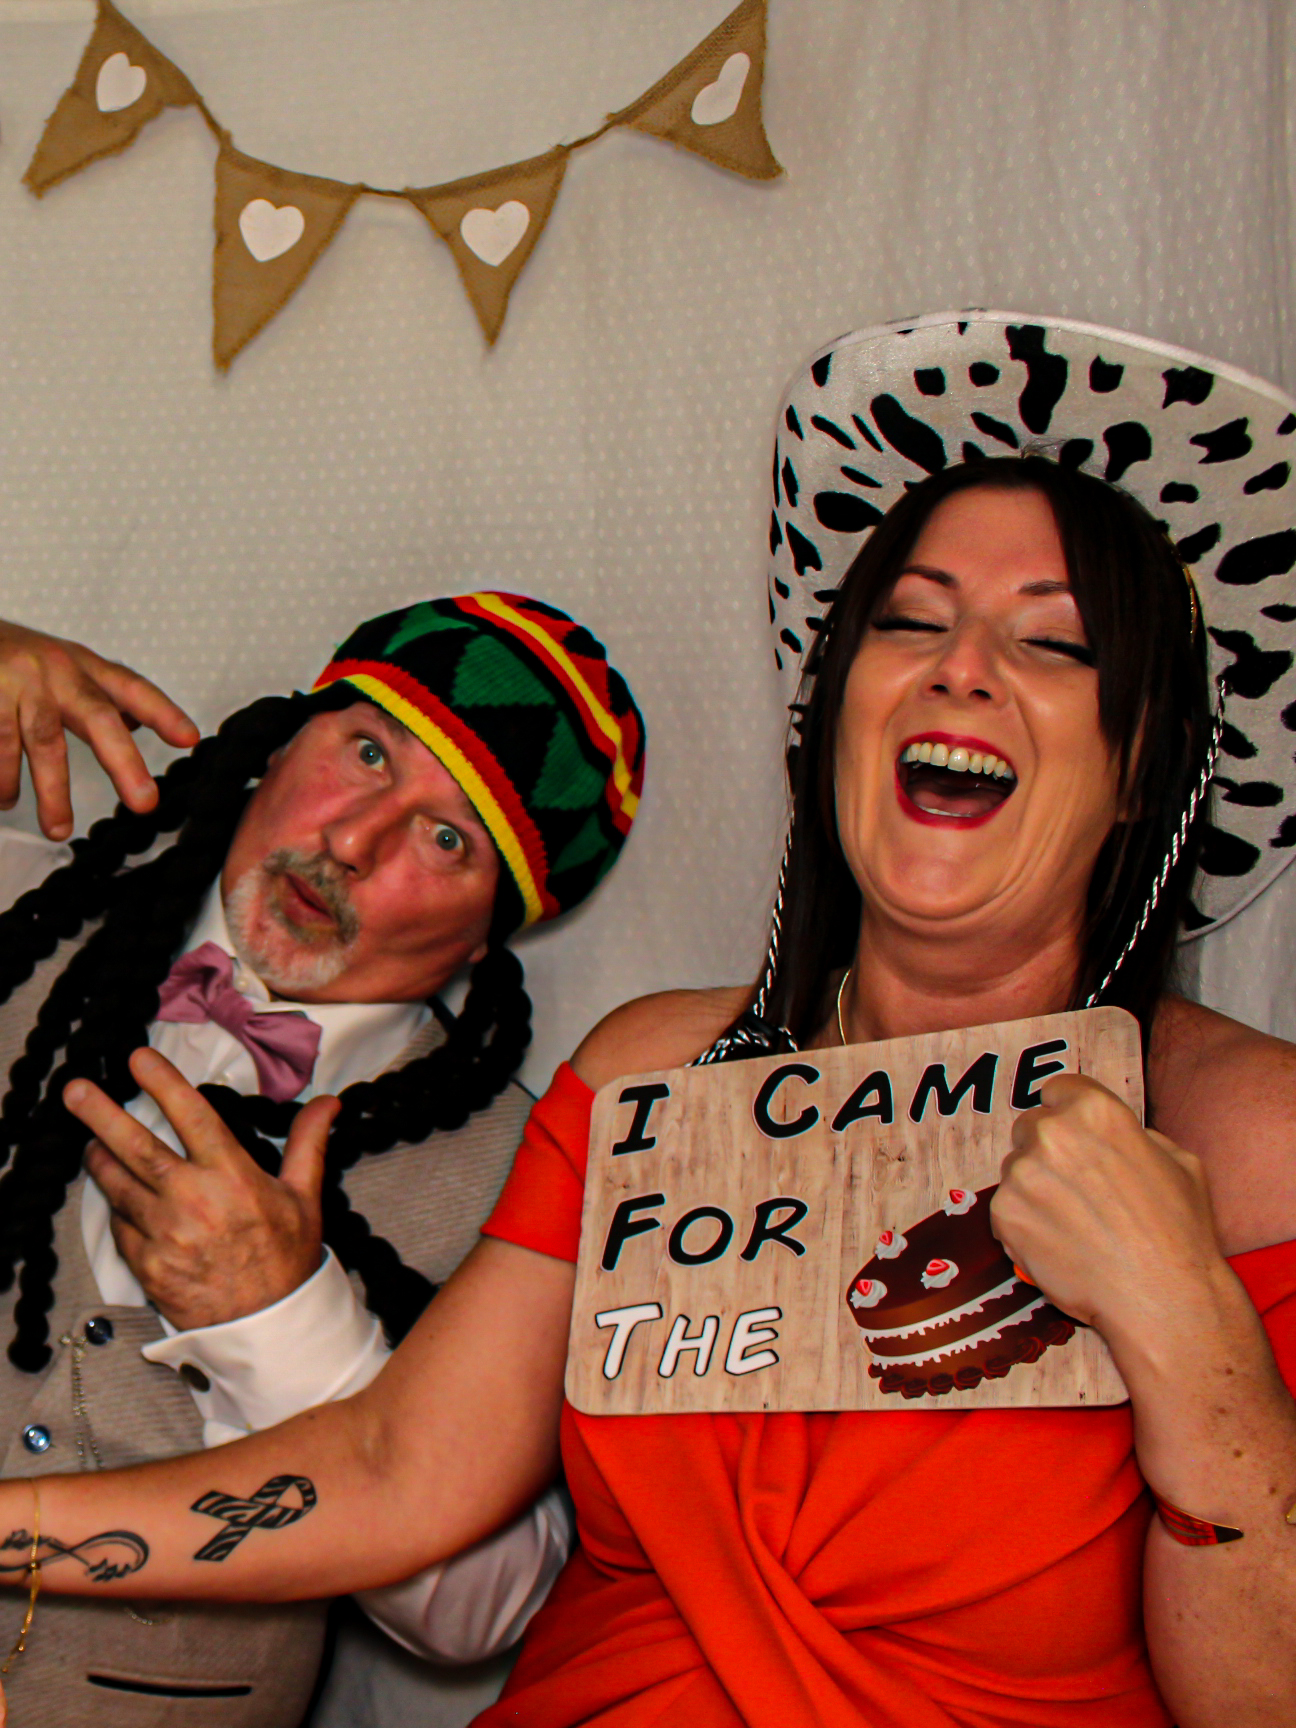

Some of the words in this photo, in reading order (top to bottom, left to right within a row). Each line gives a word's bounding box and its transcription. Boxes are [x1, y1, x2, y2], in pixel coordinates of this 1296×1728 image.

[611, 1083, 670, 1157] I
[752, 1039, 1068, 1140] CAME
[601, 1193, 808, 1272] FOR
[595, 1302, 783, 1380] THE
